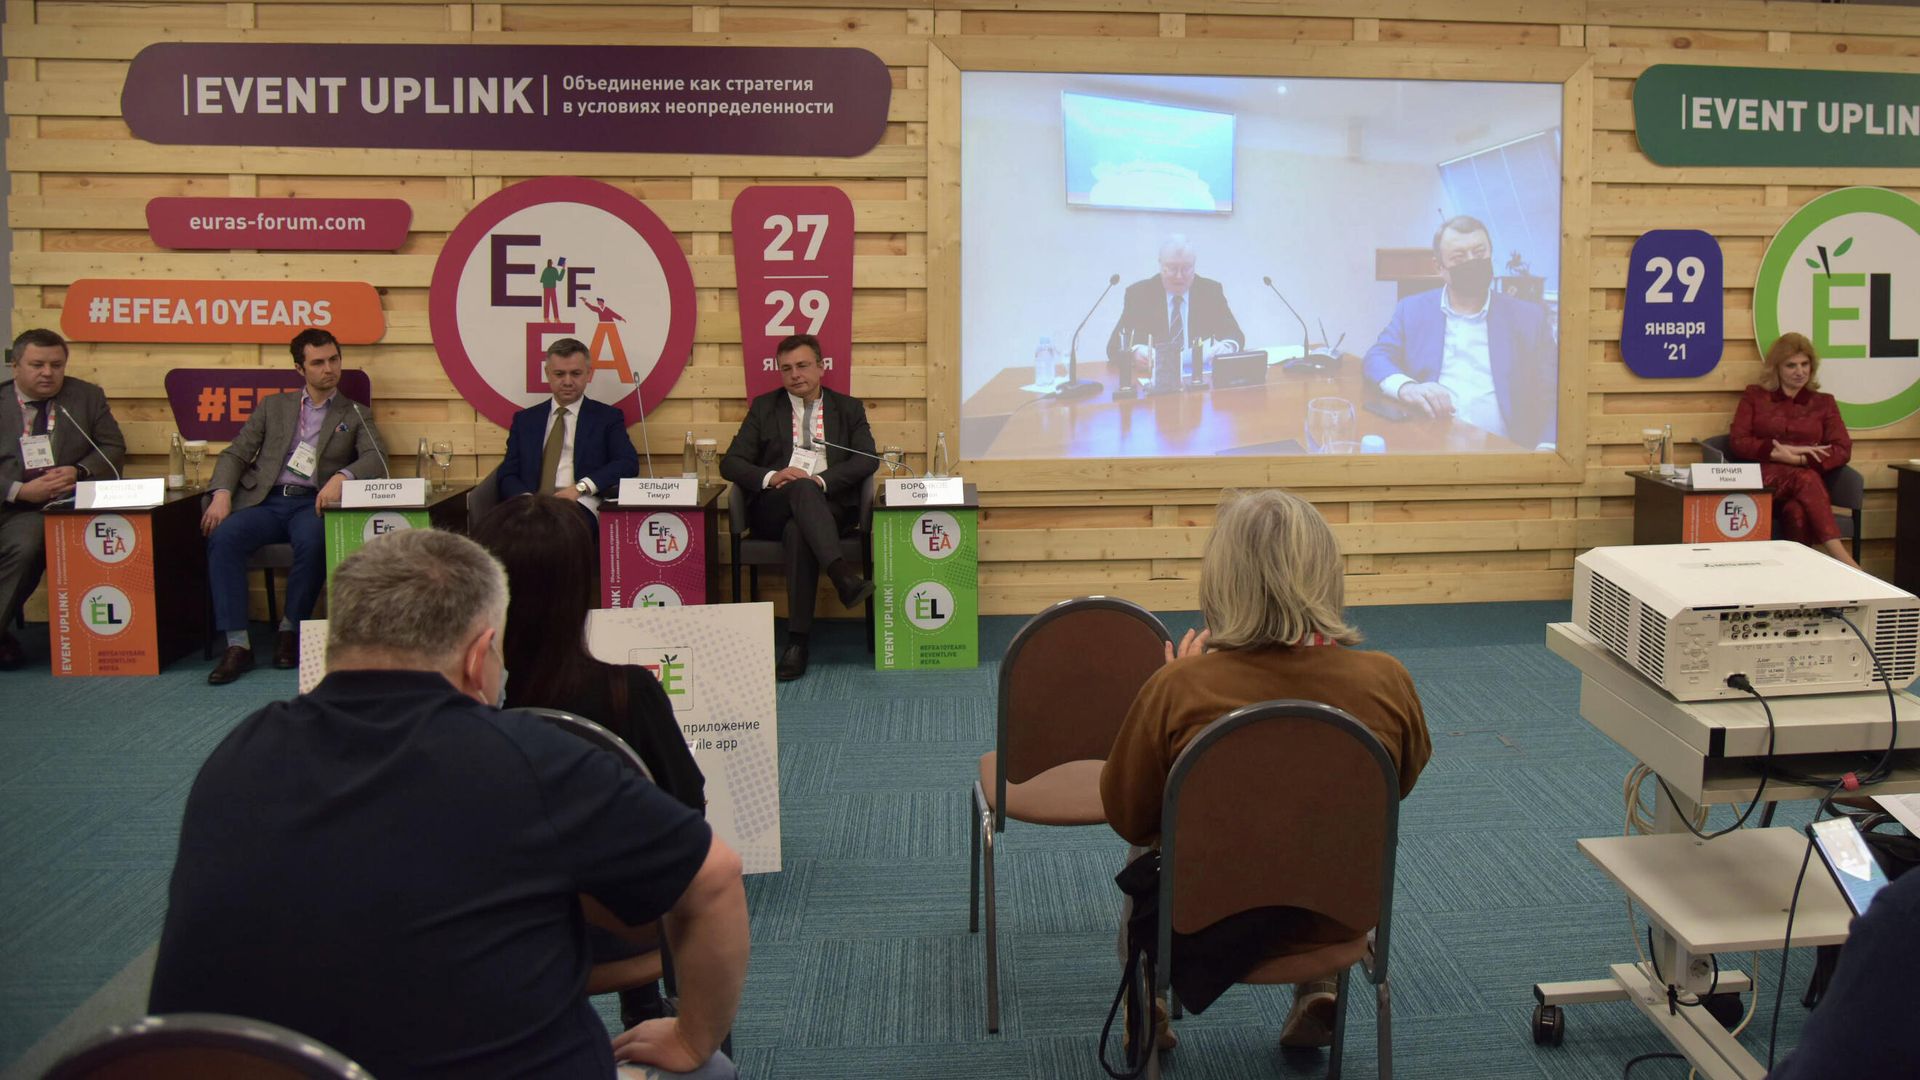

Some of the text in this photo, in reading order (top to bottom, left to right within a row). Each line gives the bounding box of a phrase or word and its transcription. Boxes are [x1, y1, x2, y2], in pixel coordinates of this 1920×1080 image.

[197, 77, 535, 114] EVENT UPLINK
[563, 75, 813, 94] Объединение как стратегия
[563, 101, 834, 117] в условиях неопределенности
[1692, 97, 1919, 136] EVENT UPLIN
[189, 212, 366, 230] euras-forum.com
[763, 214, 829, 261] 27
[1645, 256, 1706, 303] 29
[88, 297, 332, 326] #EFEA10YEARS
[764, 290, 830, 336] 29
[1645, 321, 1706, 338] января
[1711, 467, 1743, 475] ГВИЧИЯ
[364, 483, 403, 492] ДОЛГОВ
[638, 482, 680, 490] ЗЕЛЬДИЧ
[611, 590, 621, 608] INK
[884, 588, 894, 628] UPLINK
[59, 592, 70, 633] UPLINK
[61, 636, 72, 671] EVENT
[884, 631, 895, 665] EVENT
[683, 721, 760, 735] приложение
[716, 740, 738, 751] app
